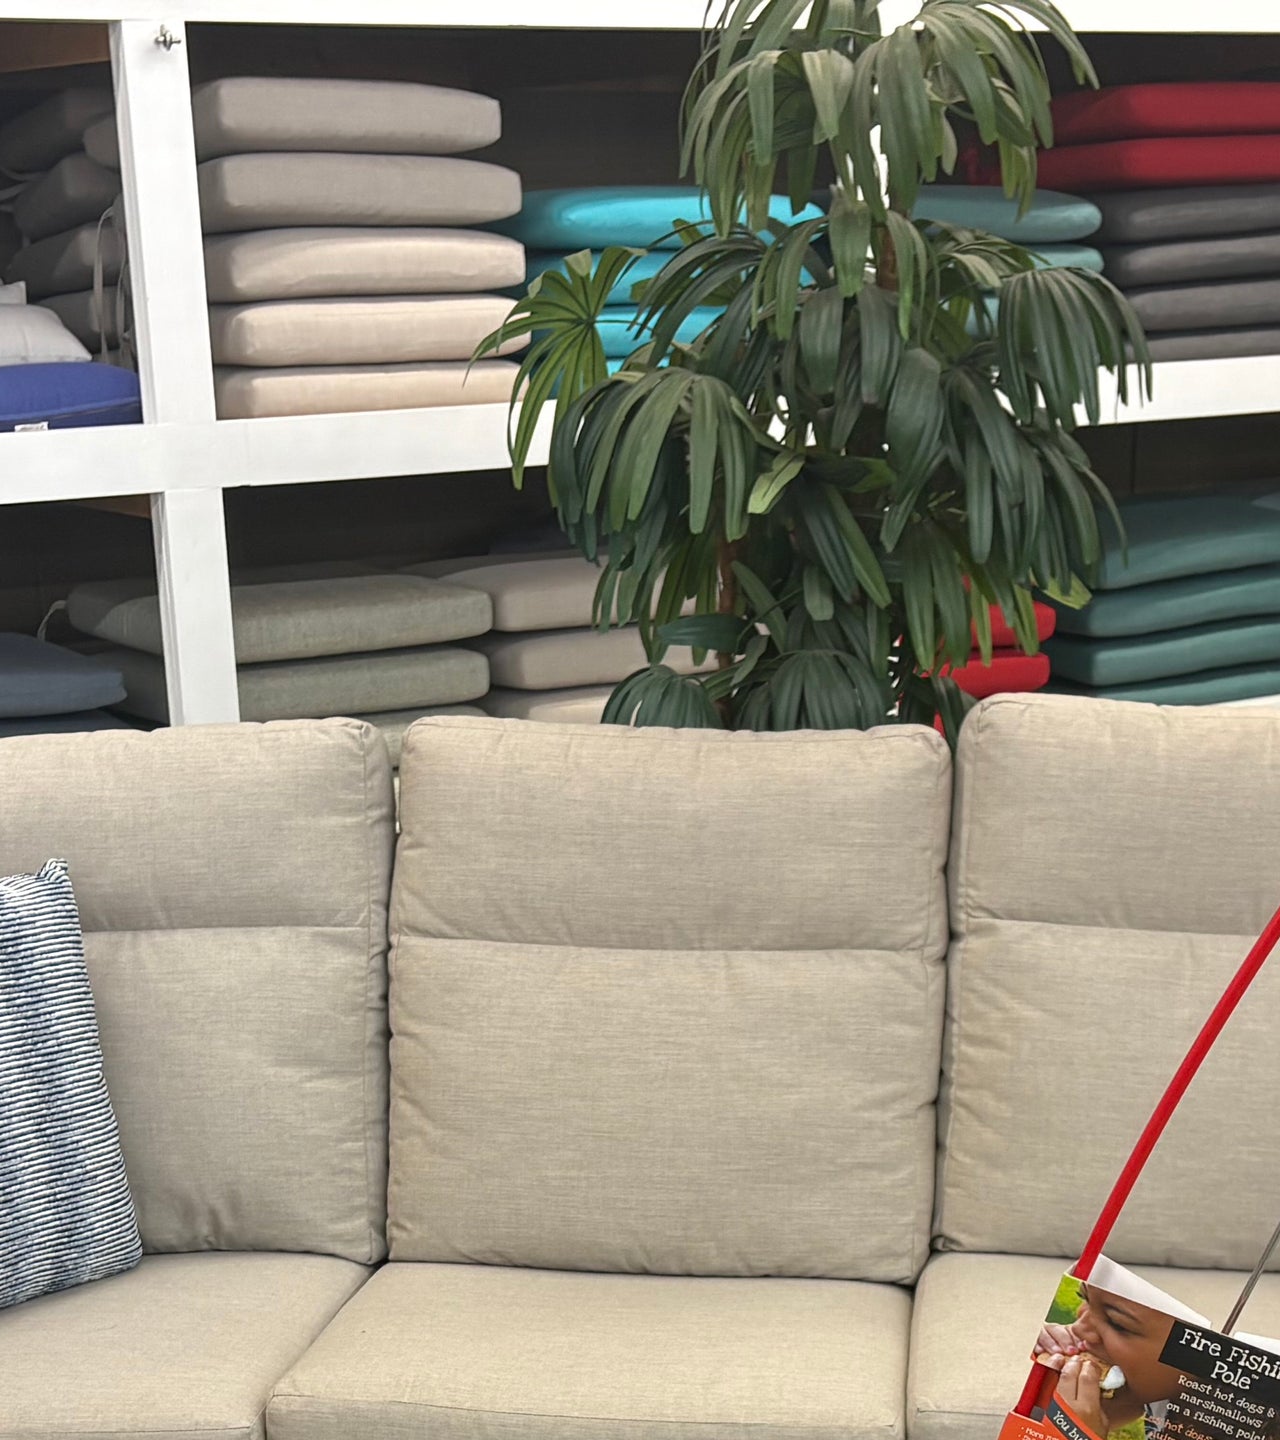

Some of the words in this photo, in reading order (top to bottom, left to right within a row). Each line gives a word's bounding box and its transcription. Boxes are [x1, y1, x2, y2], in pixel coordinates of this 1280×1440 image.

[1179, 1328, 1222, 1357] Fire
[1178, 1375, 1213, 1395] Roast
[1214, 1388, 1235, 1403] hot
[1236, 1397, 1266, 1414] dogs
[1267, 1407, 1276, 1418] &
[1179, 1391, 1264, 1428] marshmallows
[1051, 1410, 1070, 1433] You
[1164, 1419, 1183, 1433] hot
[1166, 1402, 1180, 1413] on
[1183, 1407, 1190, 1416] a
[1193, 1411, 1235, 1434] fishing
